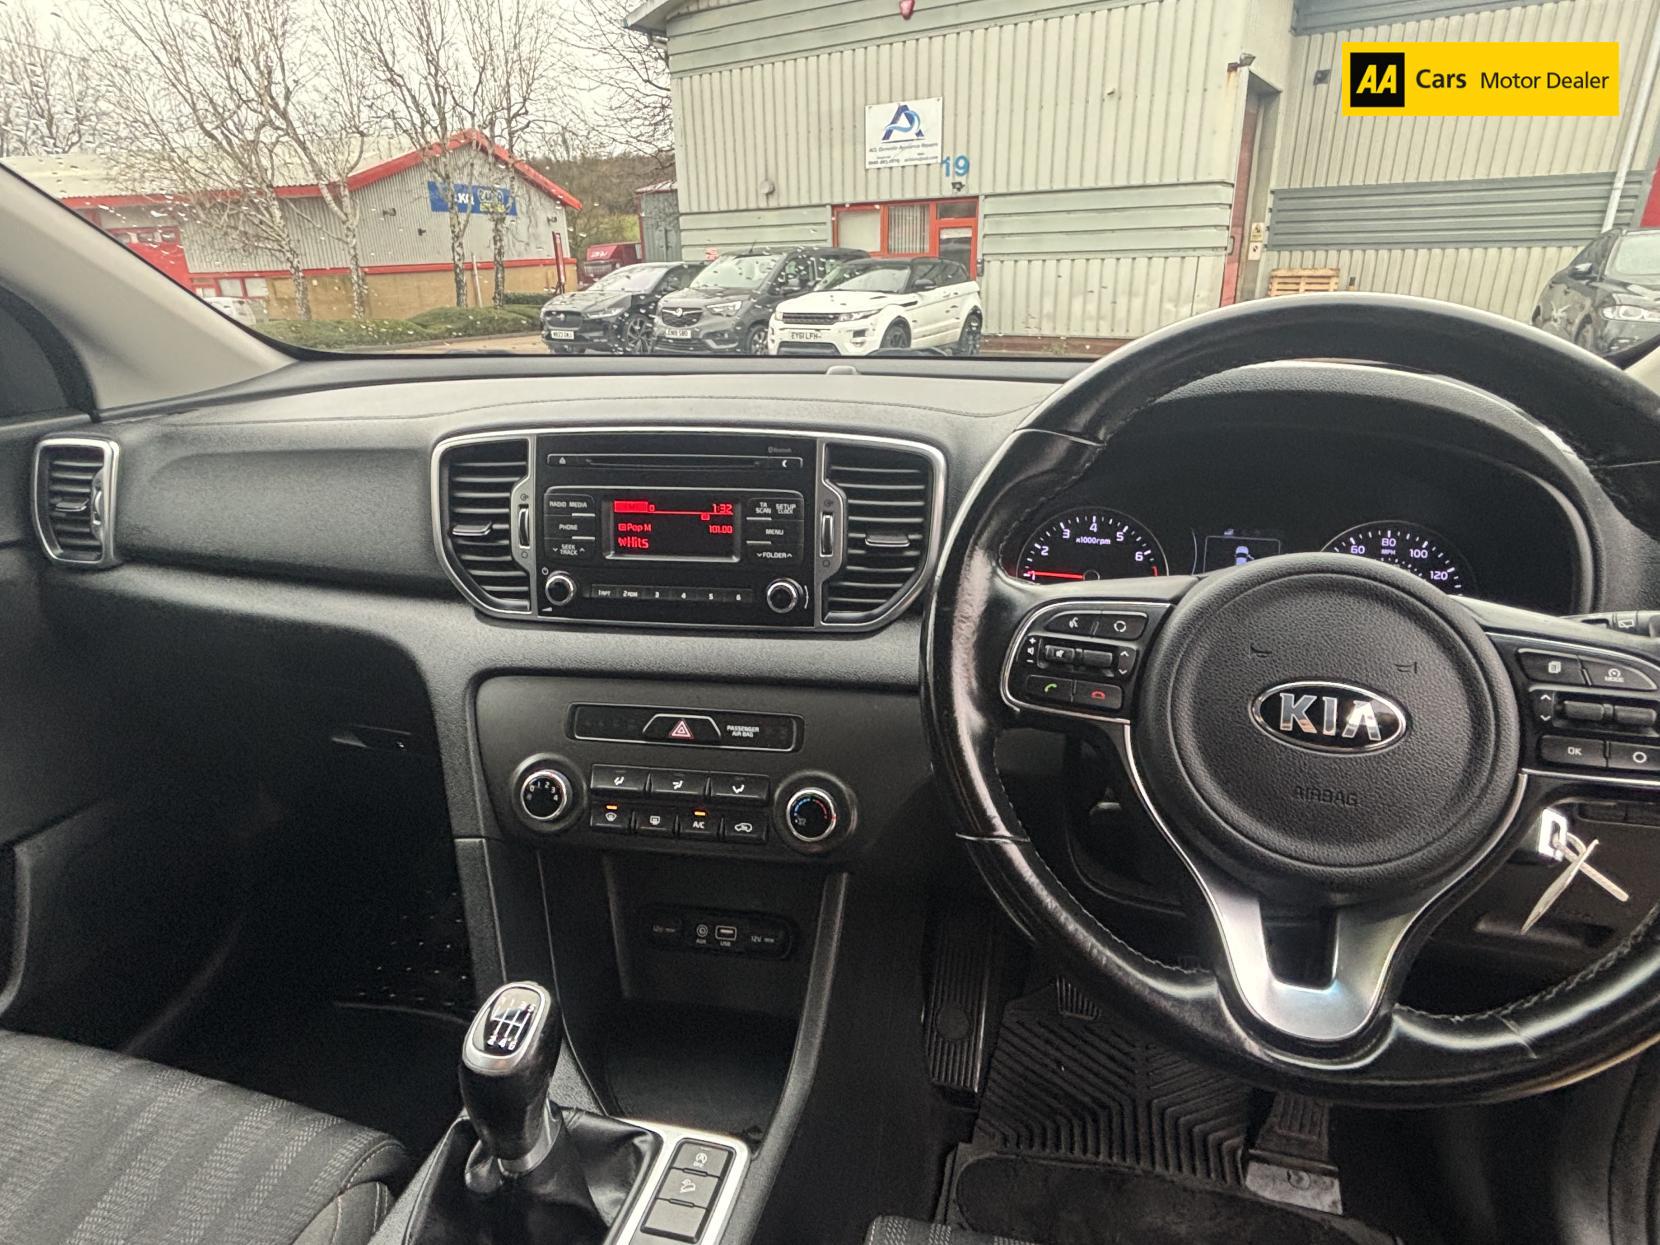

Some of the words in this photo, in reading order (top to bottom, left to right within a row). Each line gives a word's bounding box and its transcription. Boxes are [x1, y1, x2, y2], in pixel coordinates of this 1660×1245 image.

[941, 155, 970, 177] 19
[627, 523, 643, 532] Pop
[1089, 523, 1098, 533] 4
[1062, 529, 1071, 539] 3
[1116, 532, 1125, 542] 5
[1381, 538, 1396, 547] 80
[1040, 546, 1049, 556] 2
[1350, 545, 1365, 555] 60
[1409, 549, 1428, 559] 100
[1135, 552, 1144, 561] 6
[1430, 570, 1448, 580] 120
[1279, 692, 1382, 741] KIA
[1567, 746, 1582, 756] OK
